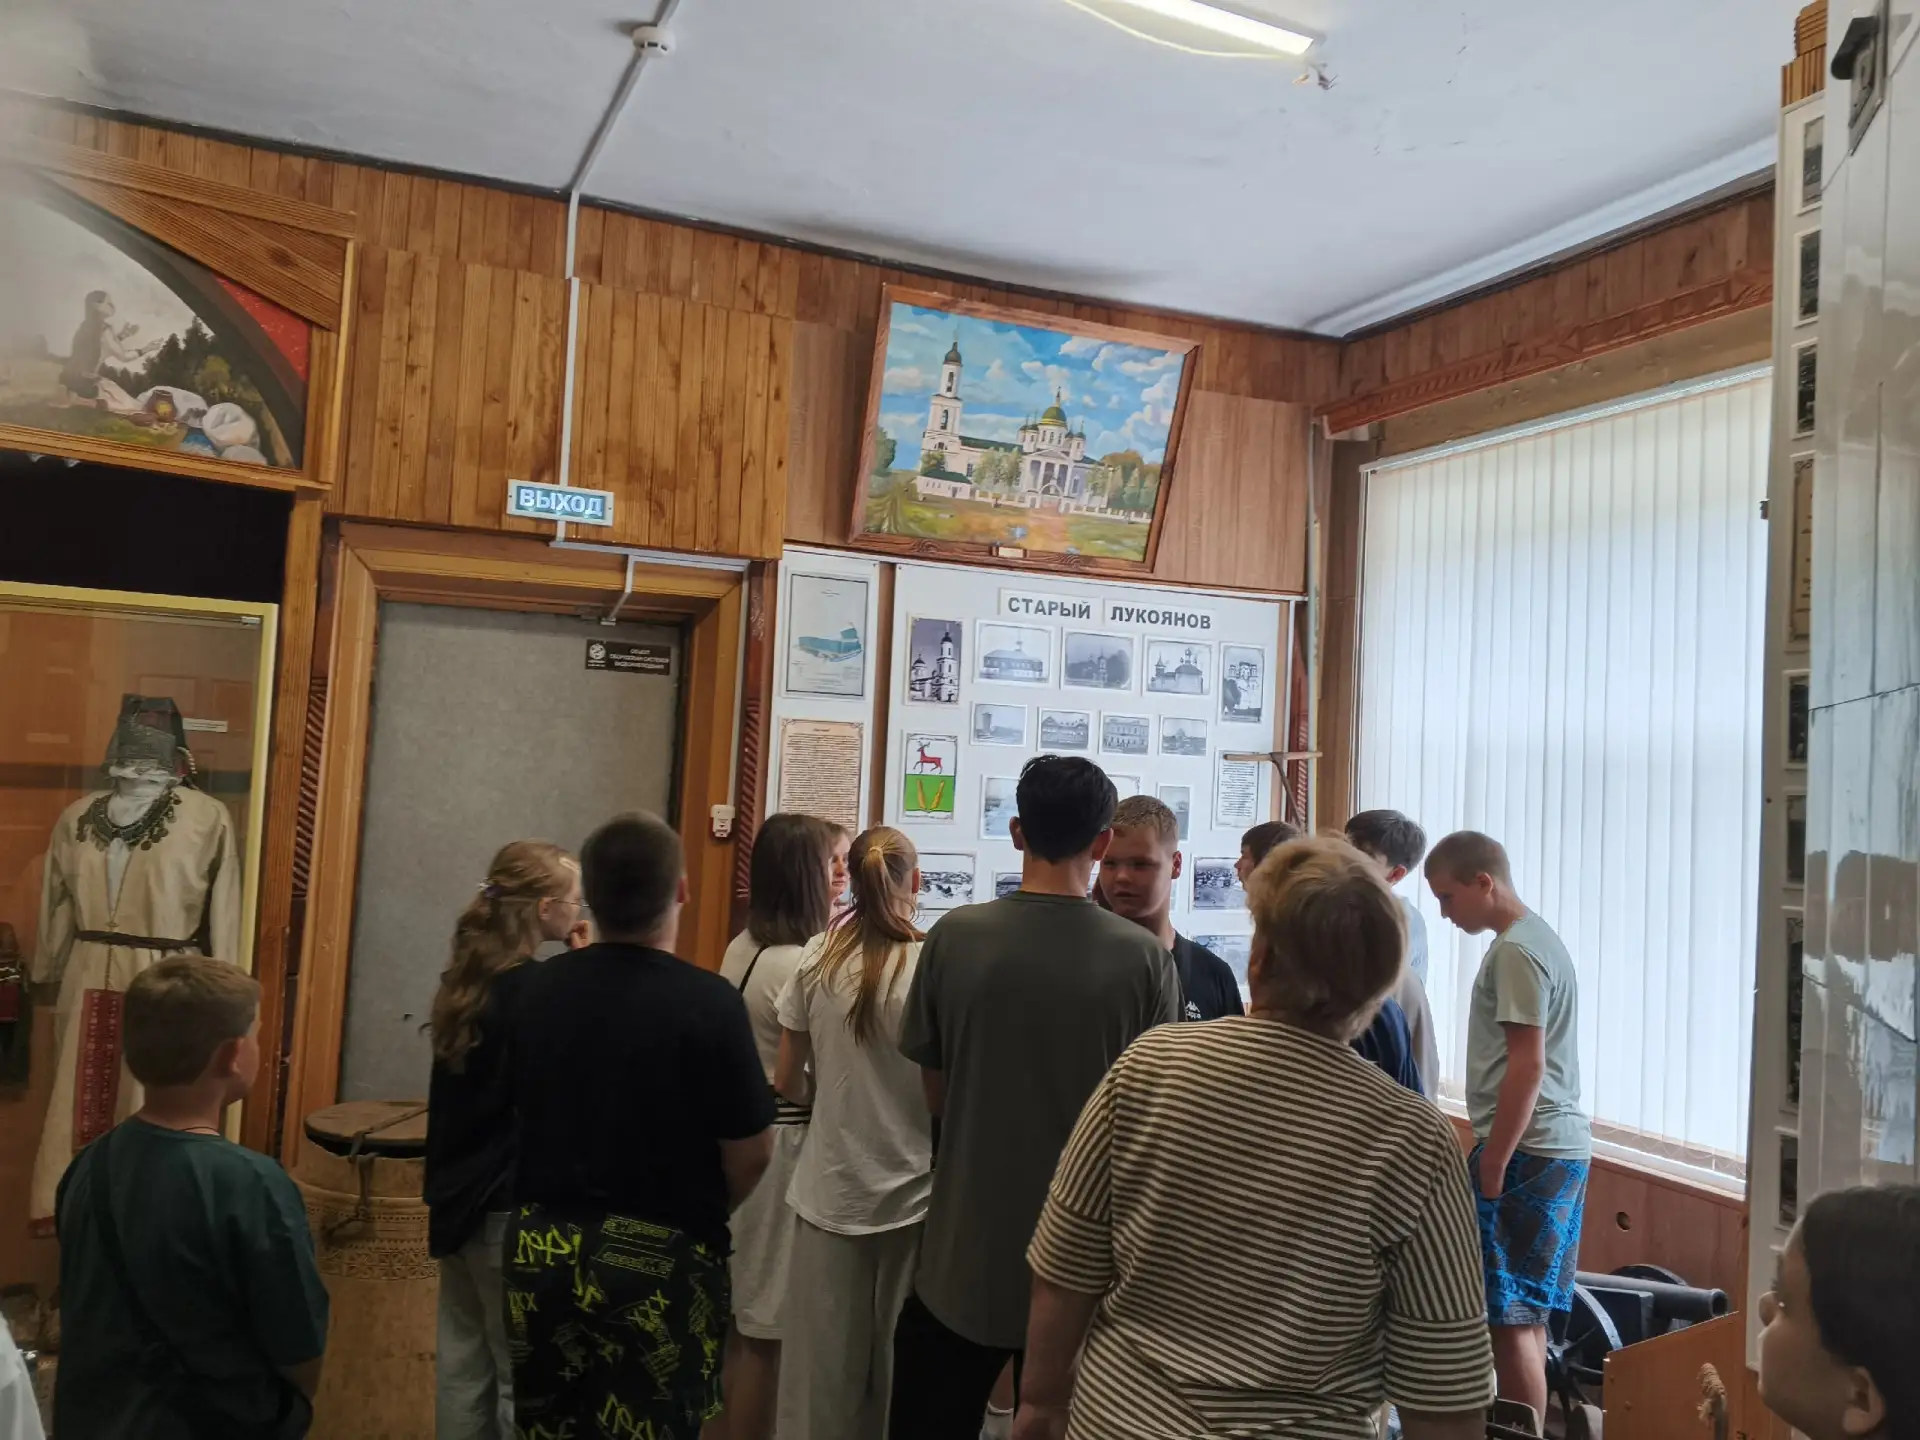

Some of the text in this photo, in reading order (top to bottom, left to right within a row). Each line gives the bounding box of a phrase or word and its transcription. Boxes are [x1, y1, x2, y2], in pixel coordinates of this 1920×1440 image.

[519, 488, 603, 517] ВЫХОД
[1008, 596, 1212, 630] СТАРЫЙ ЛУКОЯНОВ
